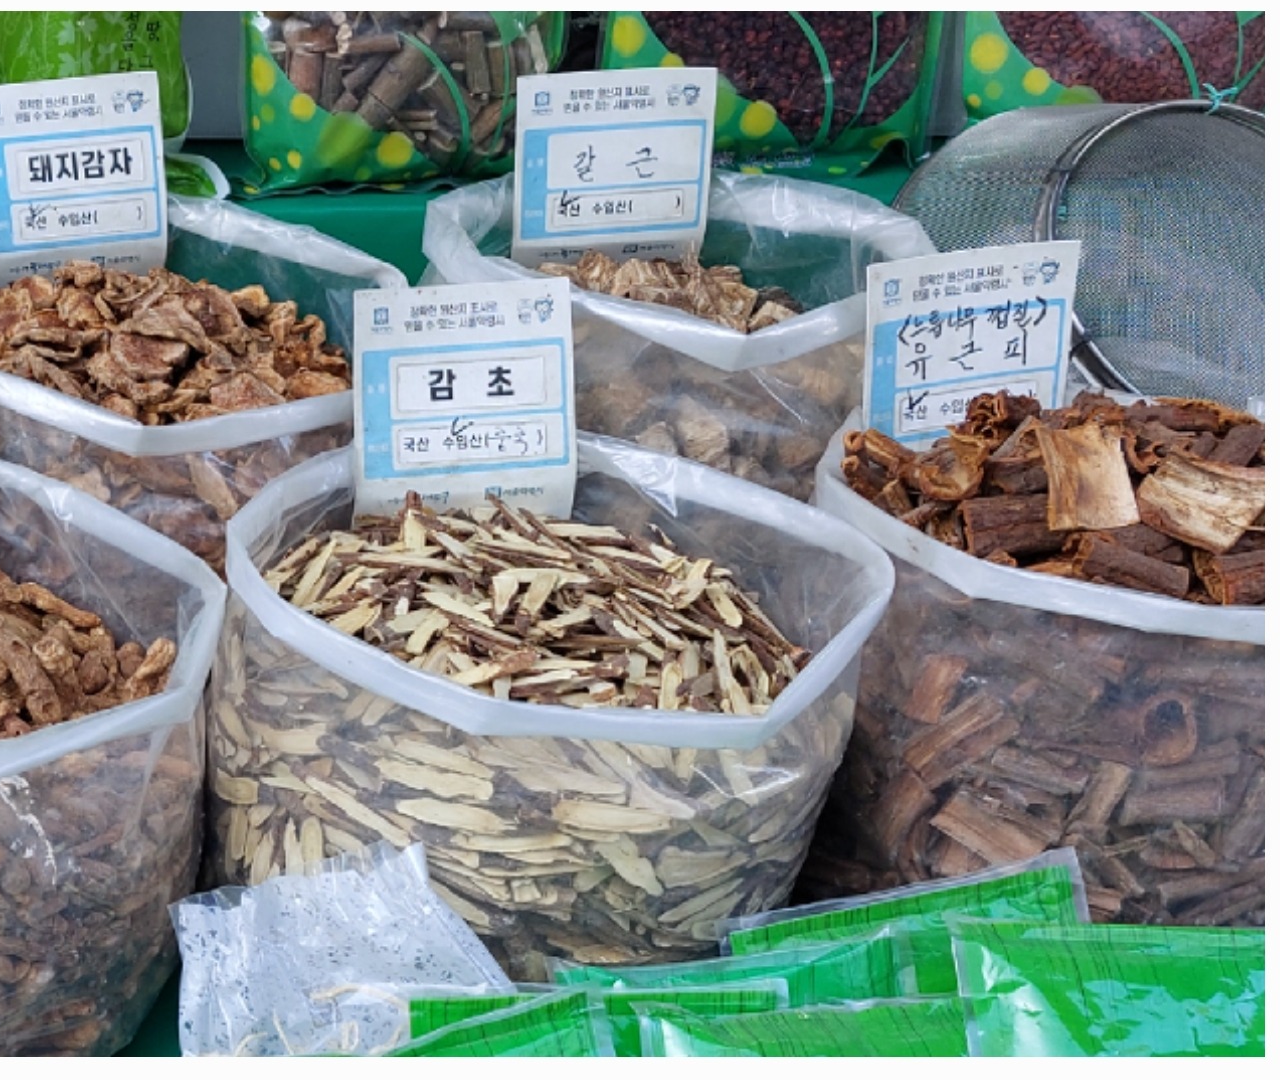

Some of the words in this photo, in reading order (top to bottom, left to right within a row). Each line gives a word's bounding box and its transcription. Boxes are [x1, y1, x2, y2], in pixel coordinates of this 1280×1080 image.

[28, 147, 133, 183] 돼지감자
[428, 369, 456, 402] 감
[486, 366, 515, 397] 초
[403, 436, 430, 453] 국산
